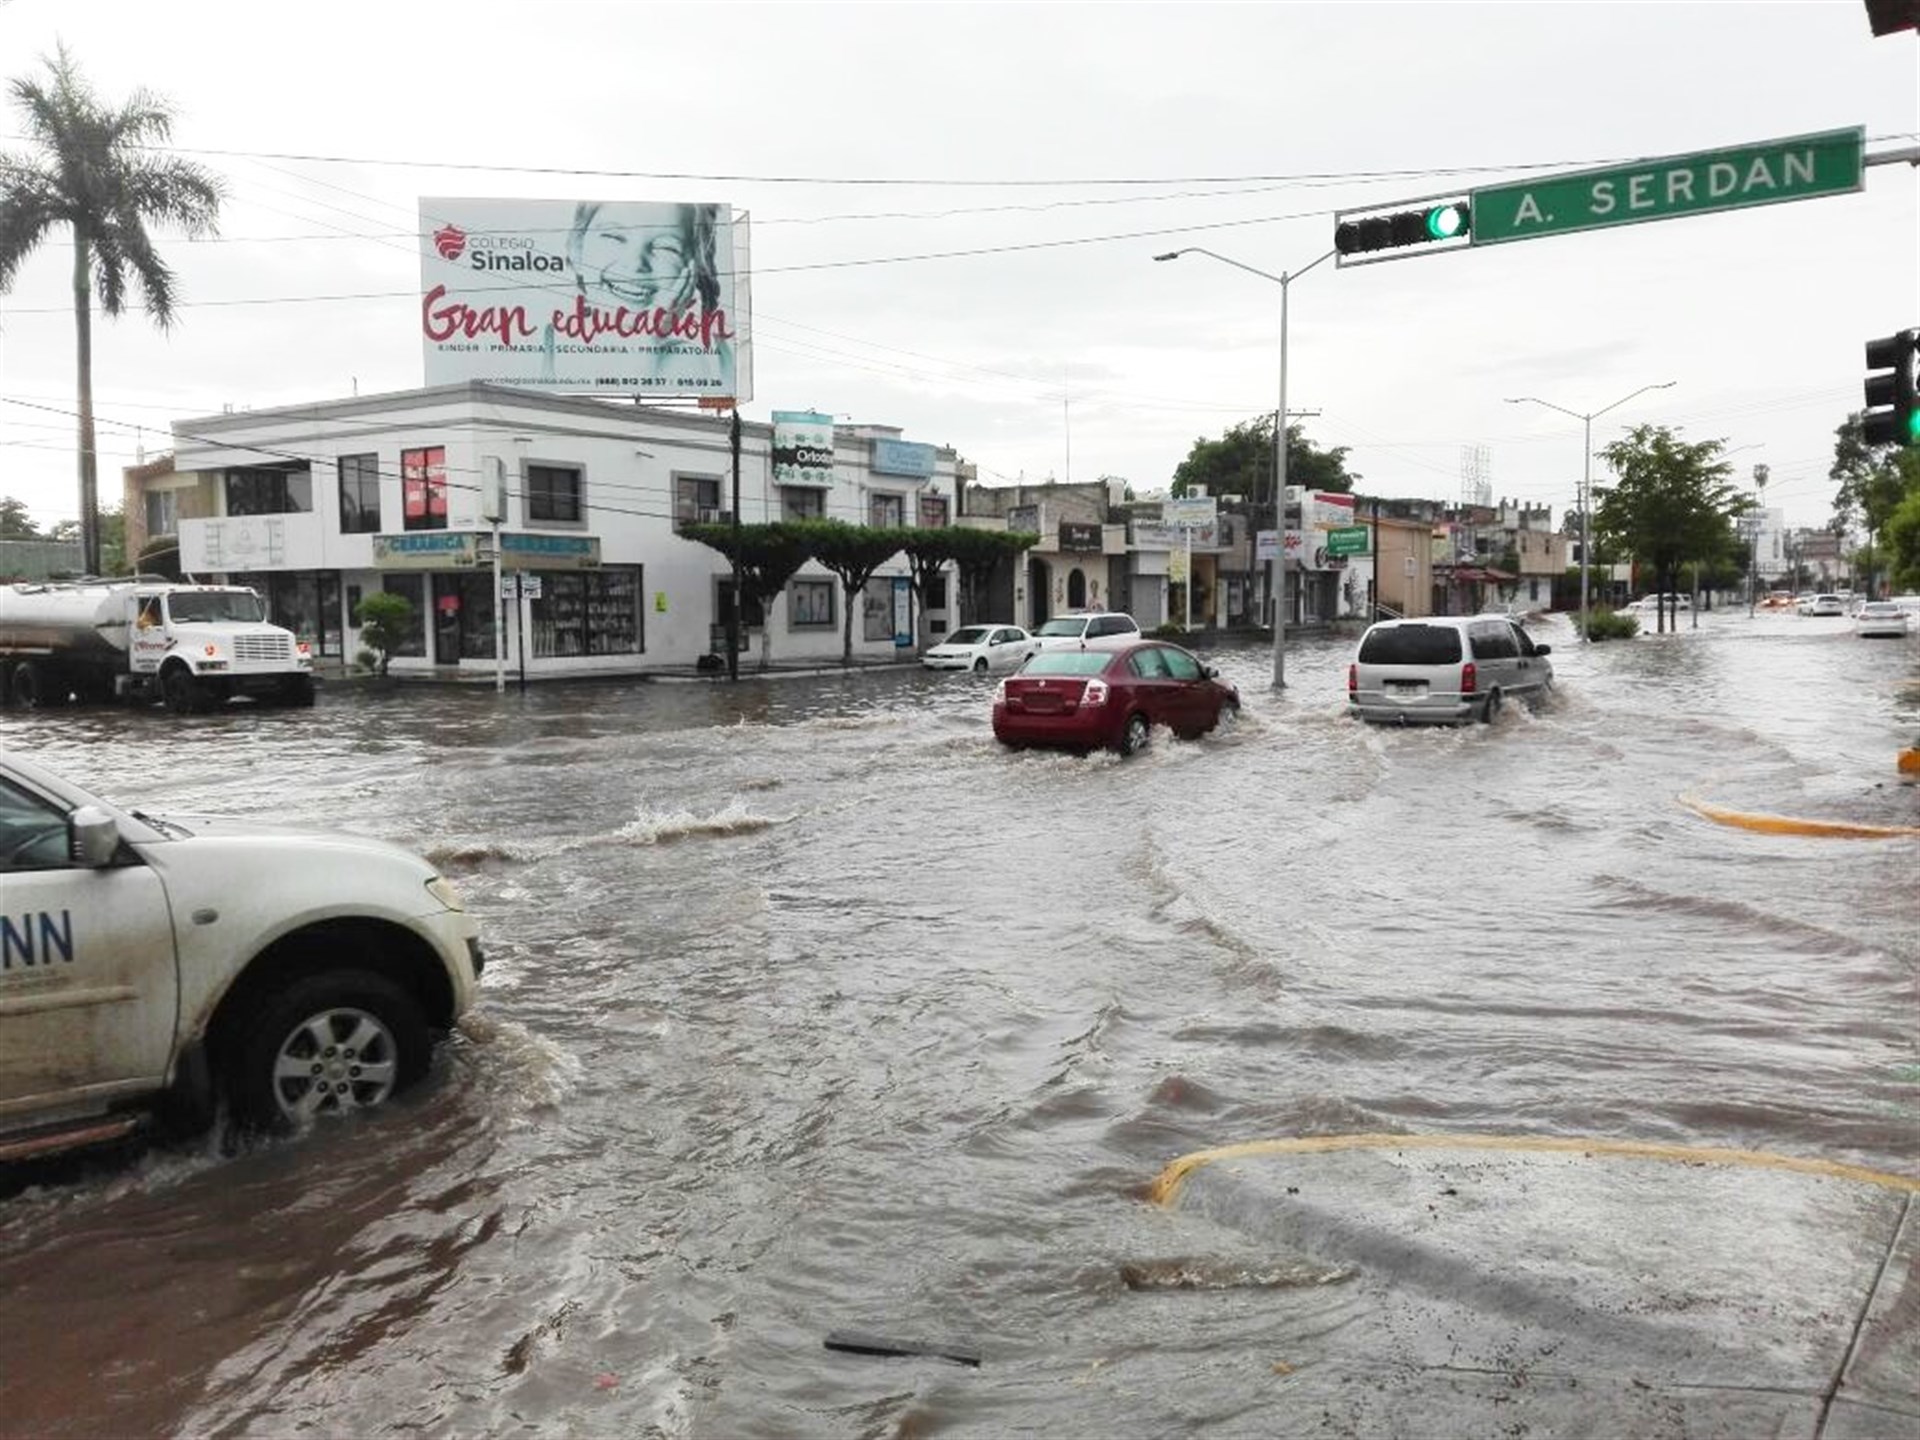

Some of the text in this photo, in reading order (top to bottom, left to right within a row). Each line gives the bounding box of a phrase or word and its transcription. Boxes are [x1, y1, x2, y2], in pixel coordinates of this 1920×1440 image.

[1513, 150, 1815, 226] A. SERDAN
[469, 237, 535, 250] COLEGIO
[471, 250, 564, 272] Sinaloa
[422, 284, 735, 347] Gran educación
[438, 344, 722, 356] KINDER PRIMARIA SECUNDARIA PREPARATORIA
